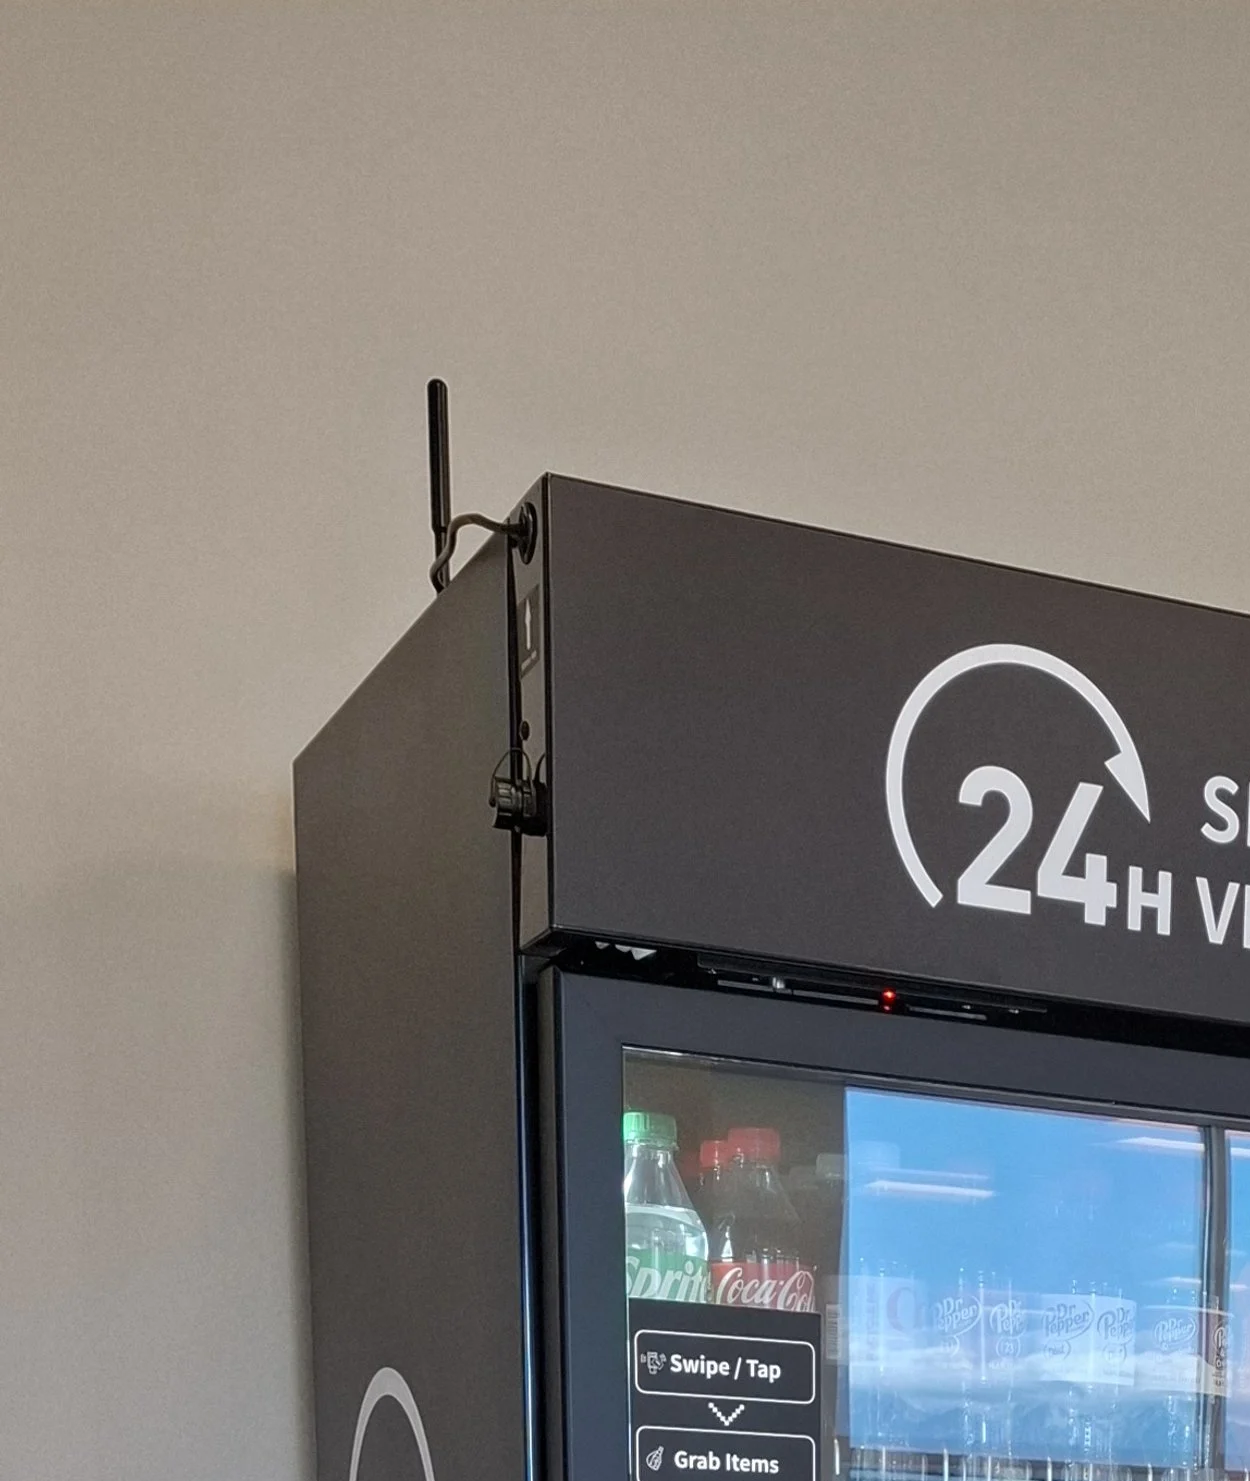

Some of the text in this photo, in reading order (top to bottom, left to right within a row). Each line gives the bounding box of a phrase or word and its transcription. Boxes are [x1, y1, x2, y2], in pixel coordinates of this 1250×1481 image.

[957, 765, 1172, 936] 24H
[626, 1255, 708, 1303] Sprit
[670, 1354, 781, 1384] Swipe / Tap
[674, 1450, 779, 1474] Grab Items
